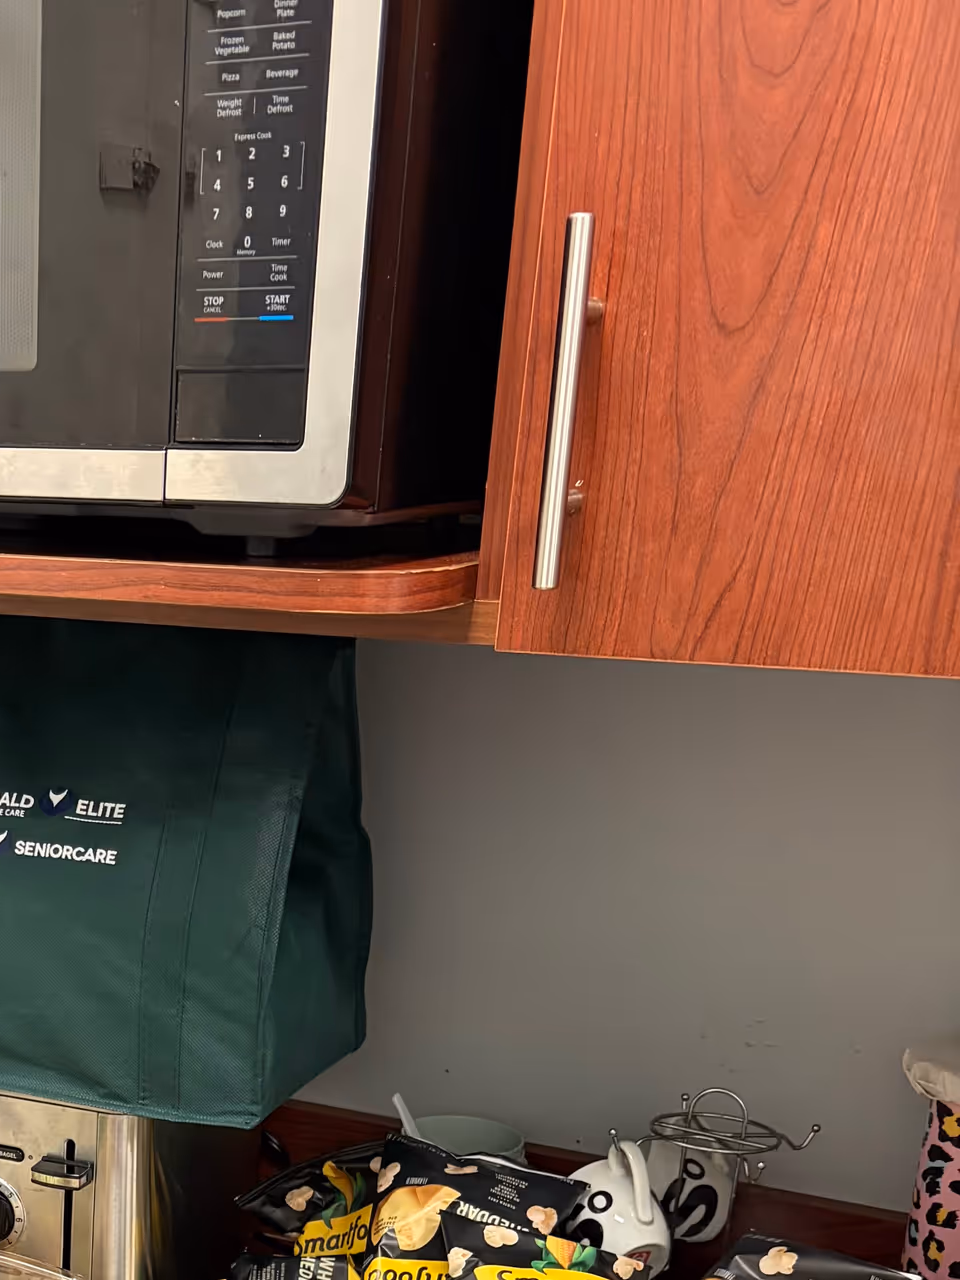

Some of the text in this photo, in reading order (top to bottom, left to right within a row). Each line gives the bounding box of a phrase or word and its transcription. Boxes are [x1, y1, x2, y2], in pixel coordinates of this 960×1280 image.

[217, 9, 246, 18] Popcorn
[276, 9, 295, 17] Plate
[273, 30, 296, 40] Baked
[221, 36, 244, 45] Frozen
[272, 41, 296, 50] Potato
[214, 45, 250, 56] Vegetable
[222, 73, 240, 82] Pizza
[266, 69, 299, 79] Beverage
[217, 98, 242, 108] Weight
[272, 95, 289, 104] Time
[217, 108, 242, 117] Defrost
[267, 104, 293, 114] Defrost
[216, 145, 290, 162] 1 2 3
[214, 175, 288, 191] 4 5 6
[213, 204, 286, 220] 7 8 9
[206, 239, 223, 249] Clock
[244, 236, 251, 248] 0
[272, 237, 291, 247] Timer
[271, 264, 288, 272] Time
[203, 270, 224, 279] Power
[270, 272, 287, 282] Cook
[203, 296, 224, 306] STOP
[265, 294, 290, 304] START
[4, 808, 25, 818] CARE
[75, 799, 127, 819] ELITE
[14, 840, 118, 865] SENIORCARE
